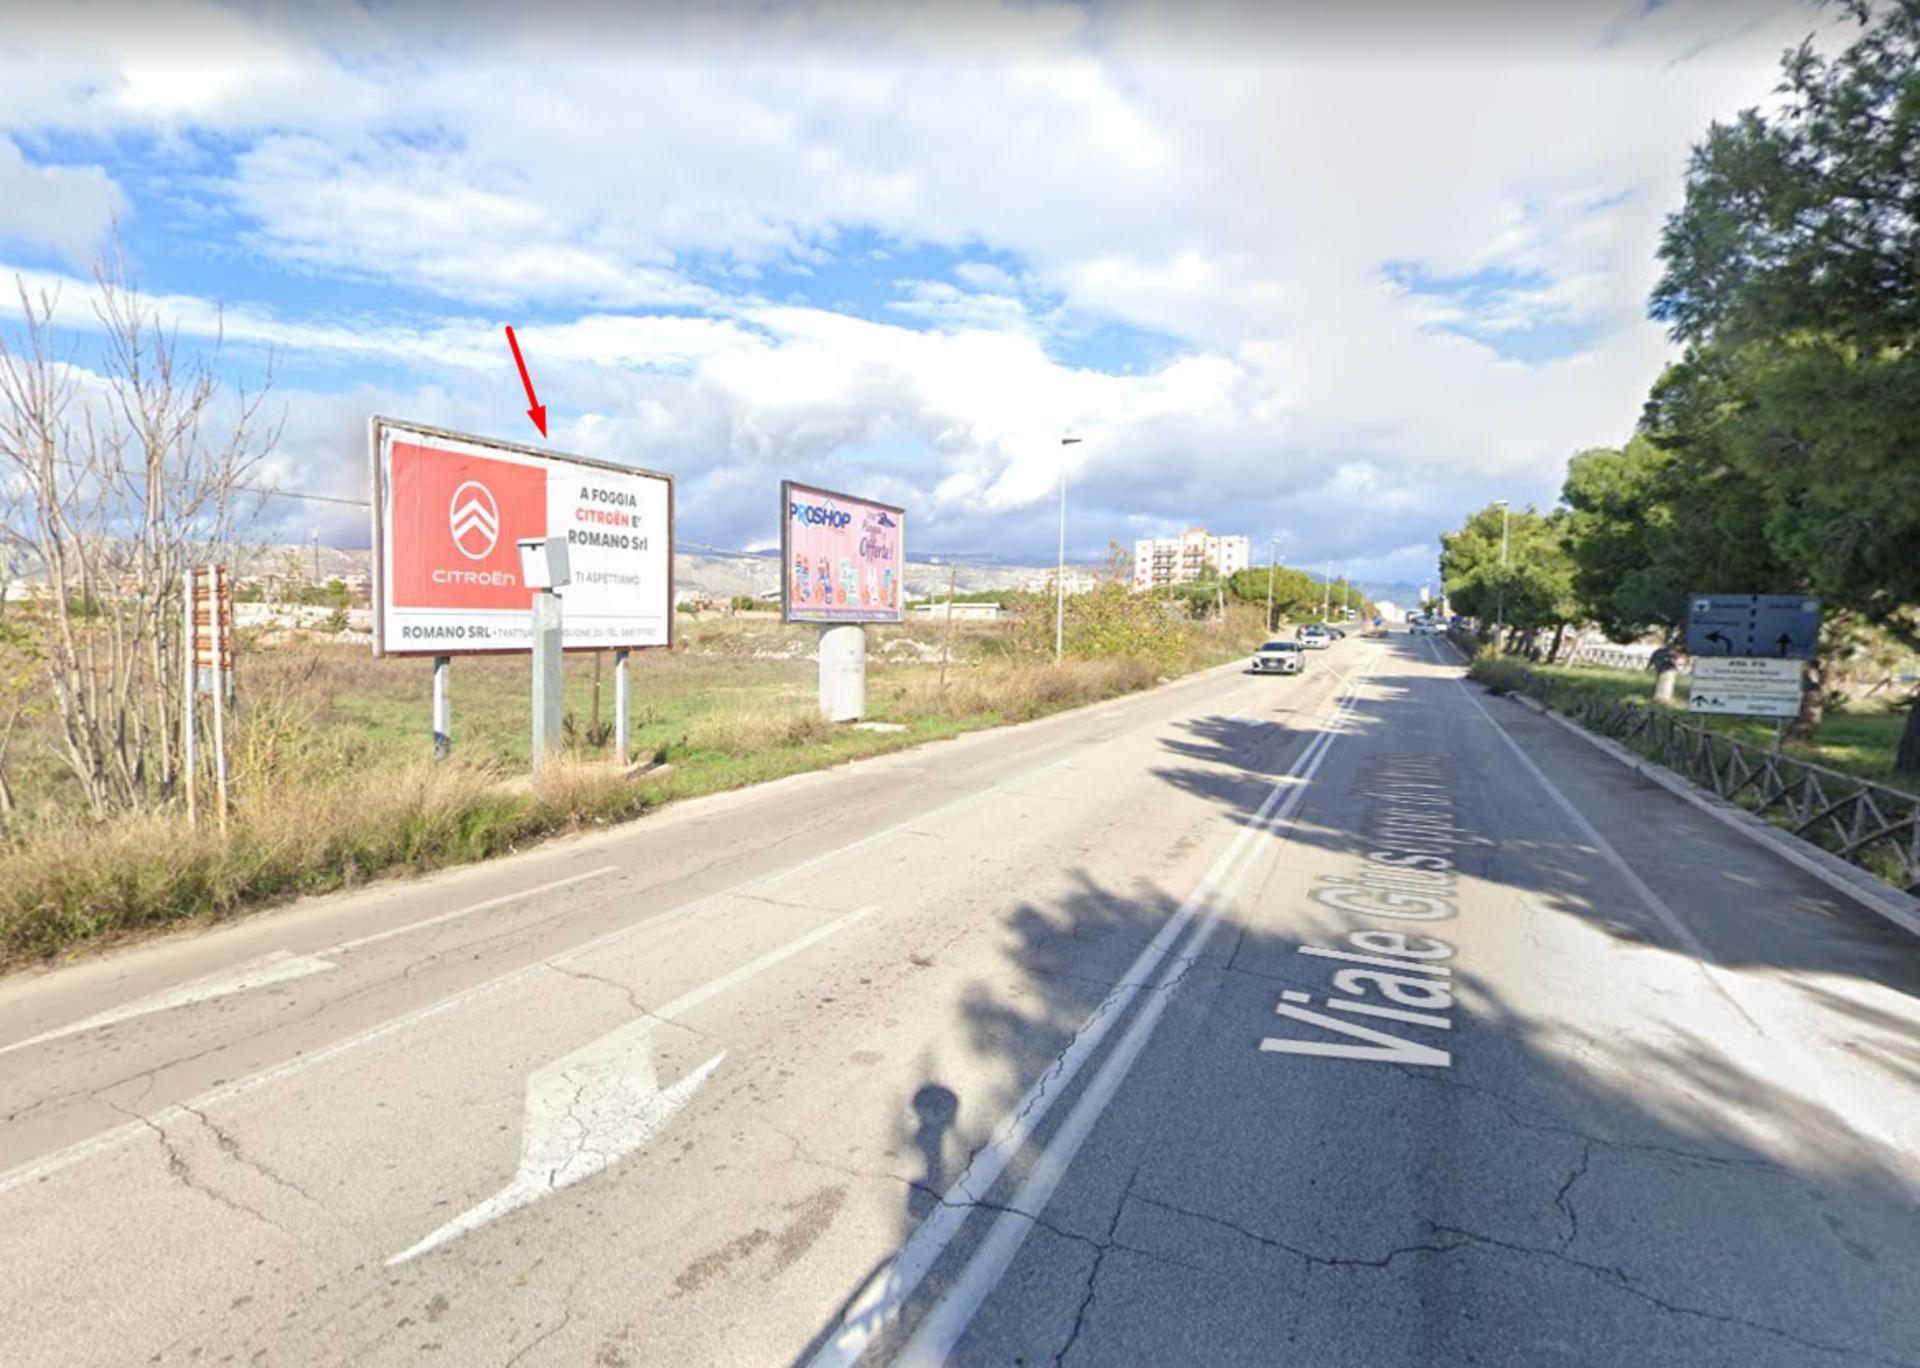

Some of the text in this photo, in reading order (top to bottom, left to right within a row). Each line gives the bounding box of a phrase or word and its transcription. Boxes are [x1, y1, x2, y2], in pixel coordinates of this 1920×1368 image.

[580, 486, 637, 508] A FOGGIA
[575, 507, 629, 527] CITROËN
[789, 502, 851, 529] PROSHOP
[568, 529, 648, 551] ROMANO Srl
[586, 572, 641, 586] ASPETTIAMO
[402, 625, 466, 639] ROMANO
[467, 625, 492, 639] SRL
